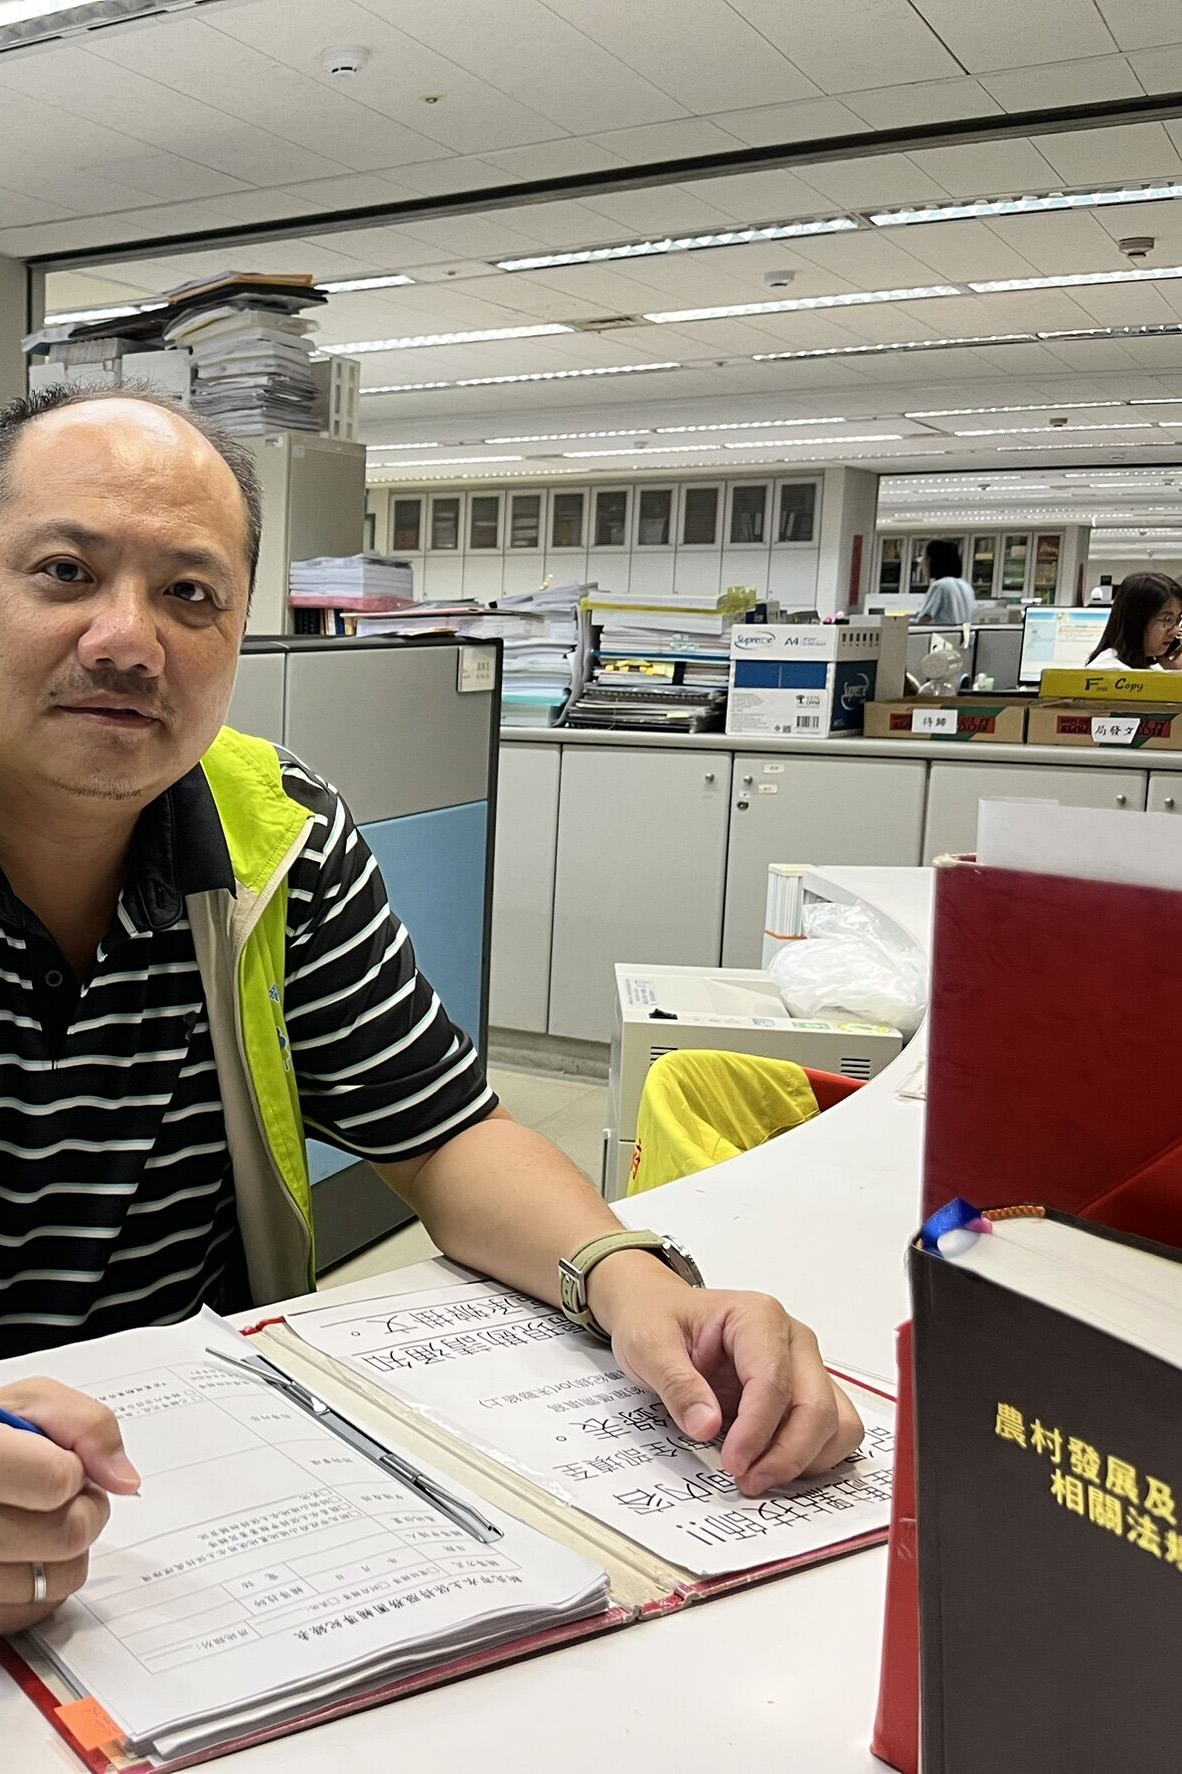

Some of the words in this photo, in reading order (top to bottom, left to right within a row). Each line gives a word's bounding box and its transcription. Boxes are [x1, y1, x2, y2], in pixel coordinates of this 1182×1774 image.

[784, 637, 799, 646] A4
[1115, 677, 1144, 692] Copy
[1095, 725, 1134, 736] 局發文
[553, 1433, 723, 1482] 府)全部填至
[995, 1401, 1178, 1527] 農村發展及
